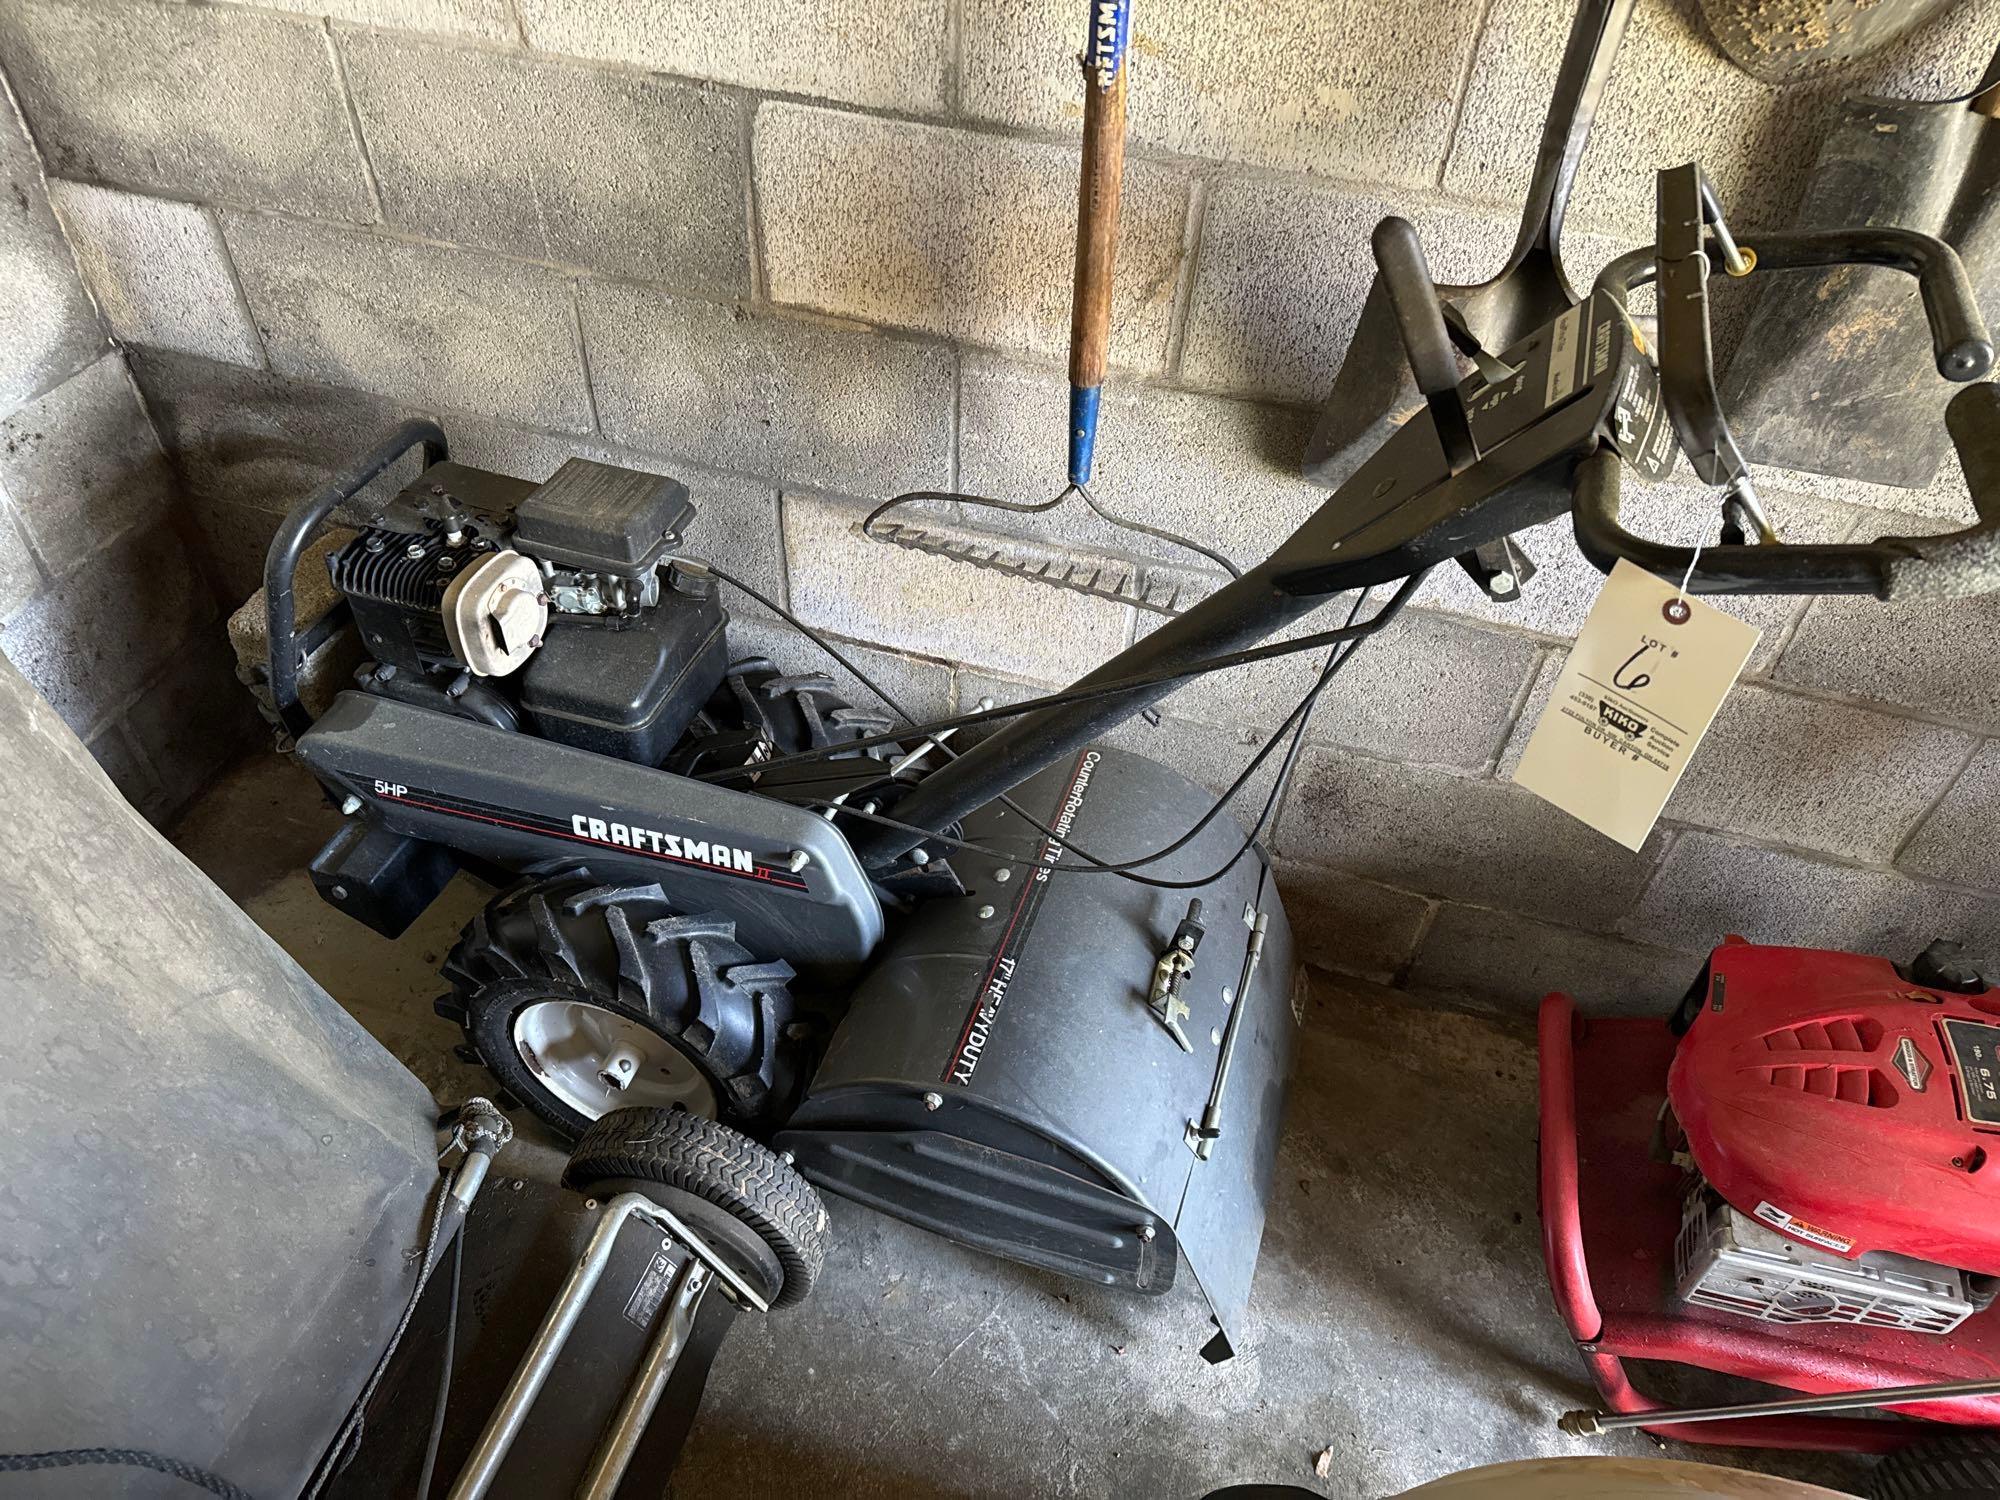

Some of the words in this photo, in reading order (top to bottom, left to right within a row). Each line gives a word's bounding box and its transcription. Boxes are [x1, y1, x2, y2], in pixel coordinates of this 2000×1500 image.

[1641, 634, 1667, 652] LOT
[1670, 650, 1679, 658] #
[1613, 645, 1651, 690] 6
[1603, 706, 1639, 732] KIKO
[1583, 726, 1627, 755] BUYER
[1649, 735, 1674, 753] Auction
[1650, 726, 1680, 748] Complete
[1646, 741, 1670, 758] Service
[374, 779, 408, 798] 5HP
[571, 814, 754, 873] CRAFTSMAN
[999, 957, 1016, 981] 17"
[1980, 1067, 1998, 1101] 6.75
[1787, 1225, 1805, 1236] HOT
[1804, 1232, 1847, 1250] SURFACES
[1807, 1223, 1852, 1246] WARNING
